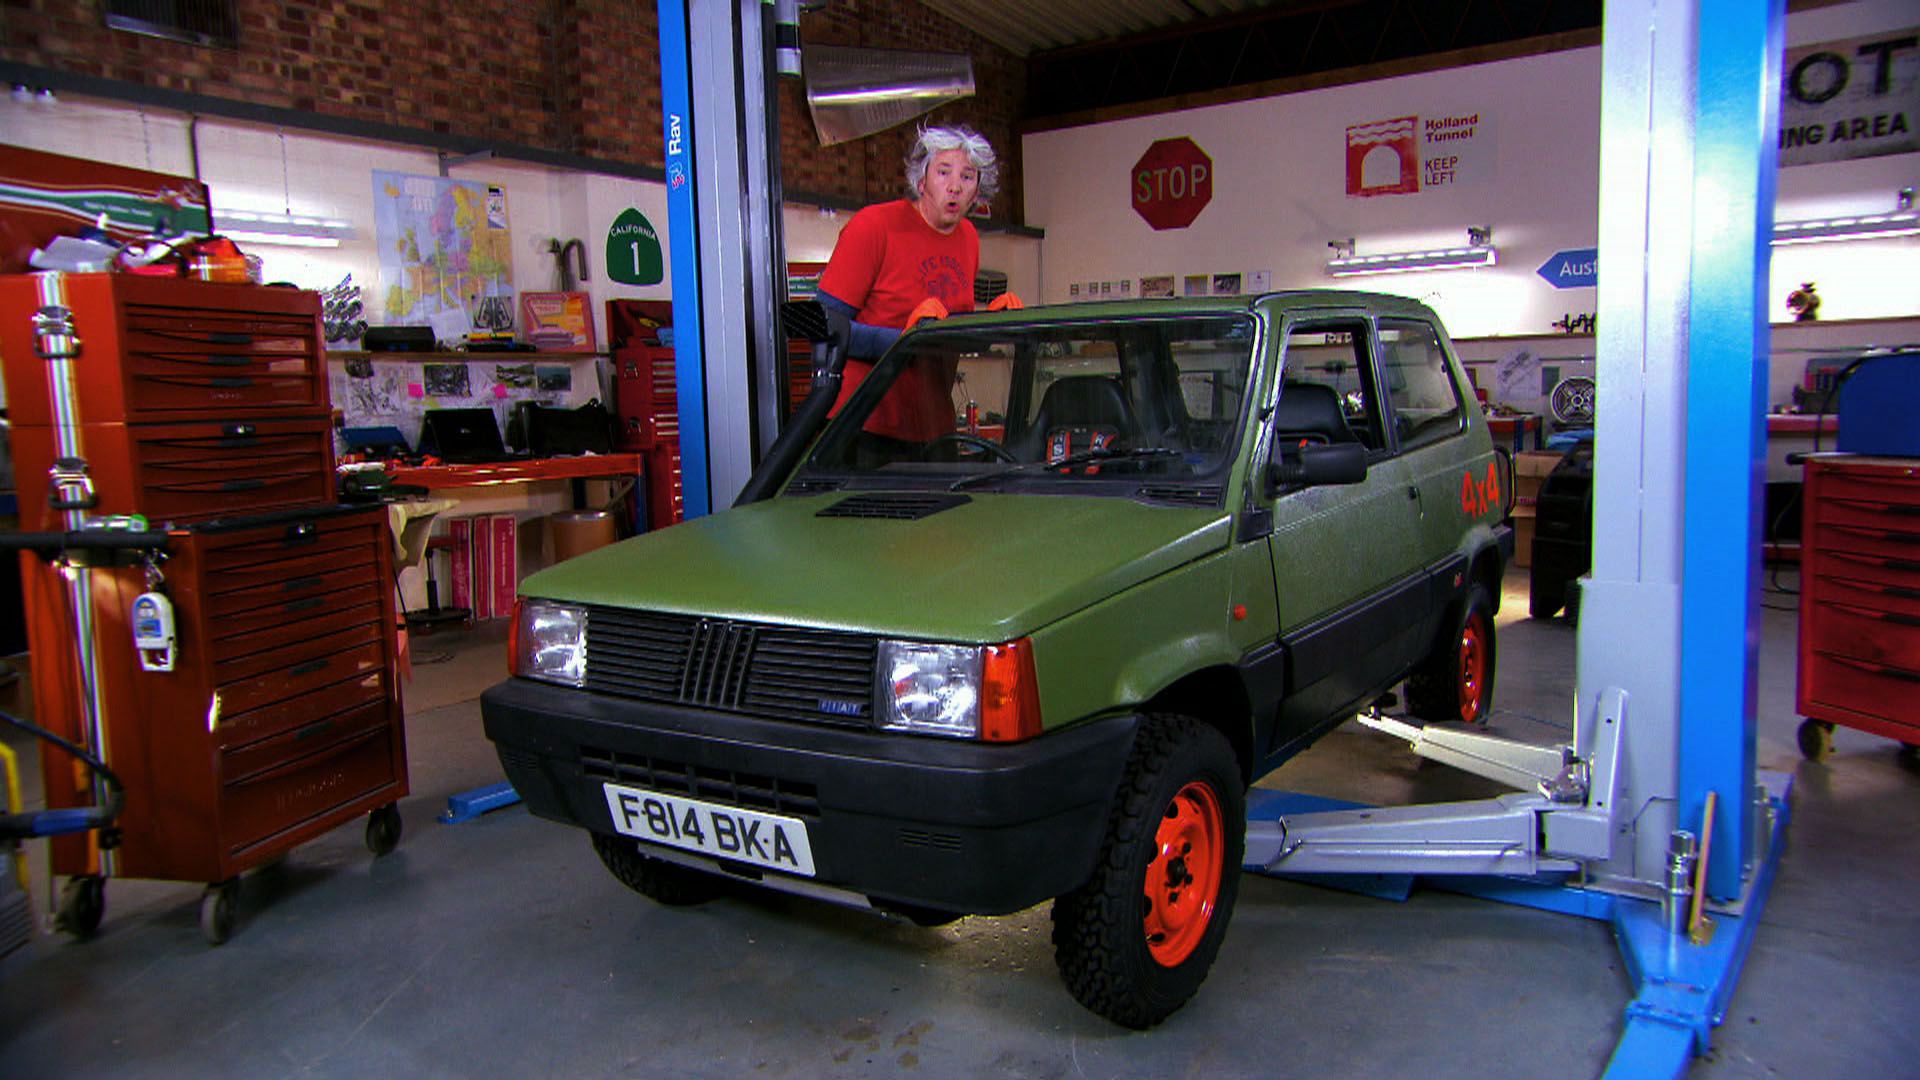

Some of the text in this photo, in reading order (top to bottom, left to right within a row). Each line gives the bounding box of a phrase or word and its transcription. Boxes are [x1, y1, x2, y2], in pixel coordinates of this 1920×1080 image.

[668, 114, 682, 155] Rav
[1425, 114, 1478, 130] Holland
[1426, 127, 1473, 143] Tunnel
[1830, 112, 1908, 143] AREA
[1425, 156, 1458, 173] KEEP
[1425, 171, 1455, 186] LEFT
[1136, 163, 1208, 202] STOP
[610, 223, 657, 241] CALIFORNIA
[631, 241, 640, 276] 1
[1461, 463, 1499, 520] 4x4
[617, 792, 799, 867] F814 BKA
